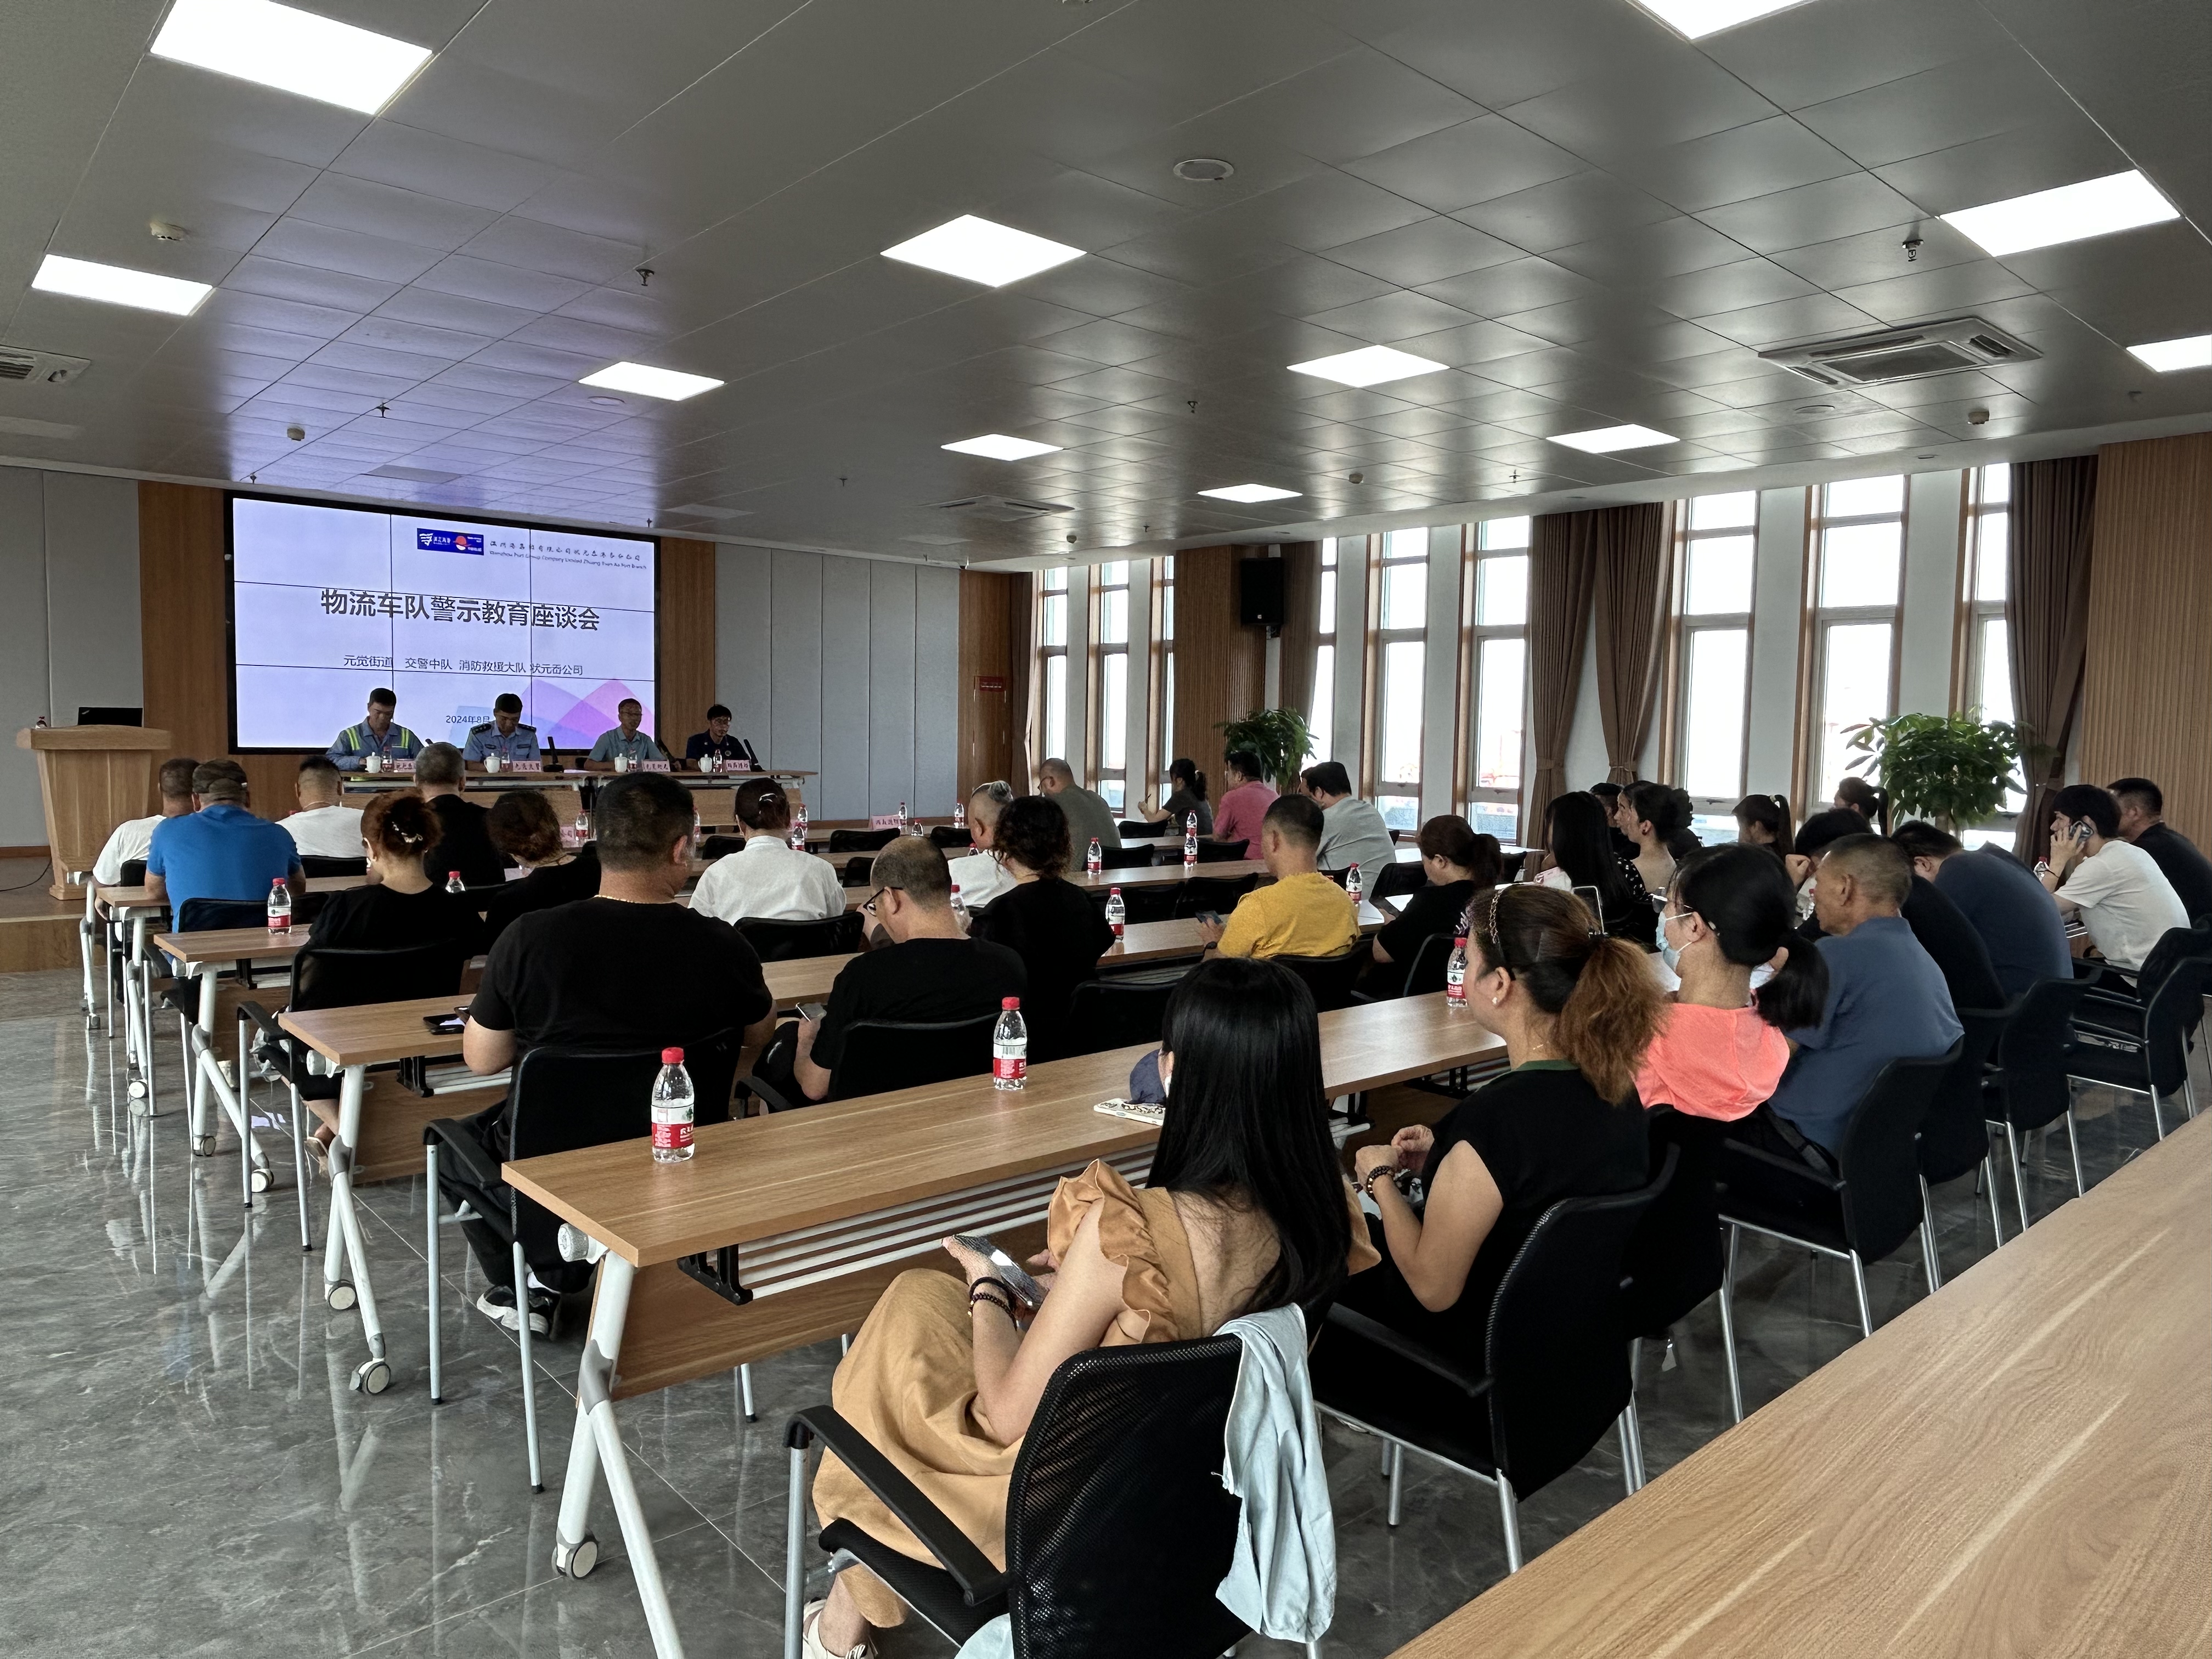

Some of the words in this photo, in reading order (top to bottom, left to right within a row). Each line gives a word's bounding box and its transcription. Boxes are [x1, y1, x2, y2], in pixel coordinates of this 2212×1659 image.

[321, 588, 600, 630] 物流车队警示教育座谈会
[405, 657, 453, 670] 交警中队
[459, 659, 527, 673] 消防救援大队
